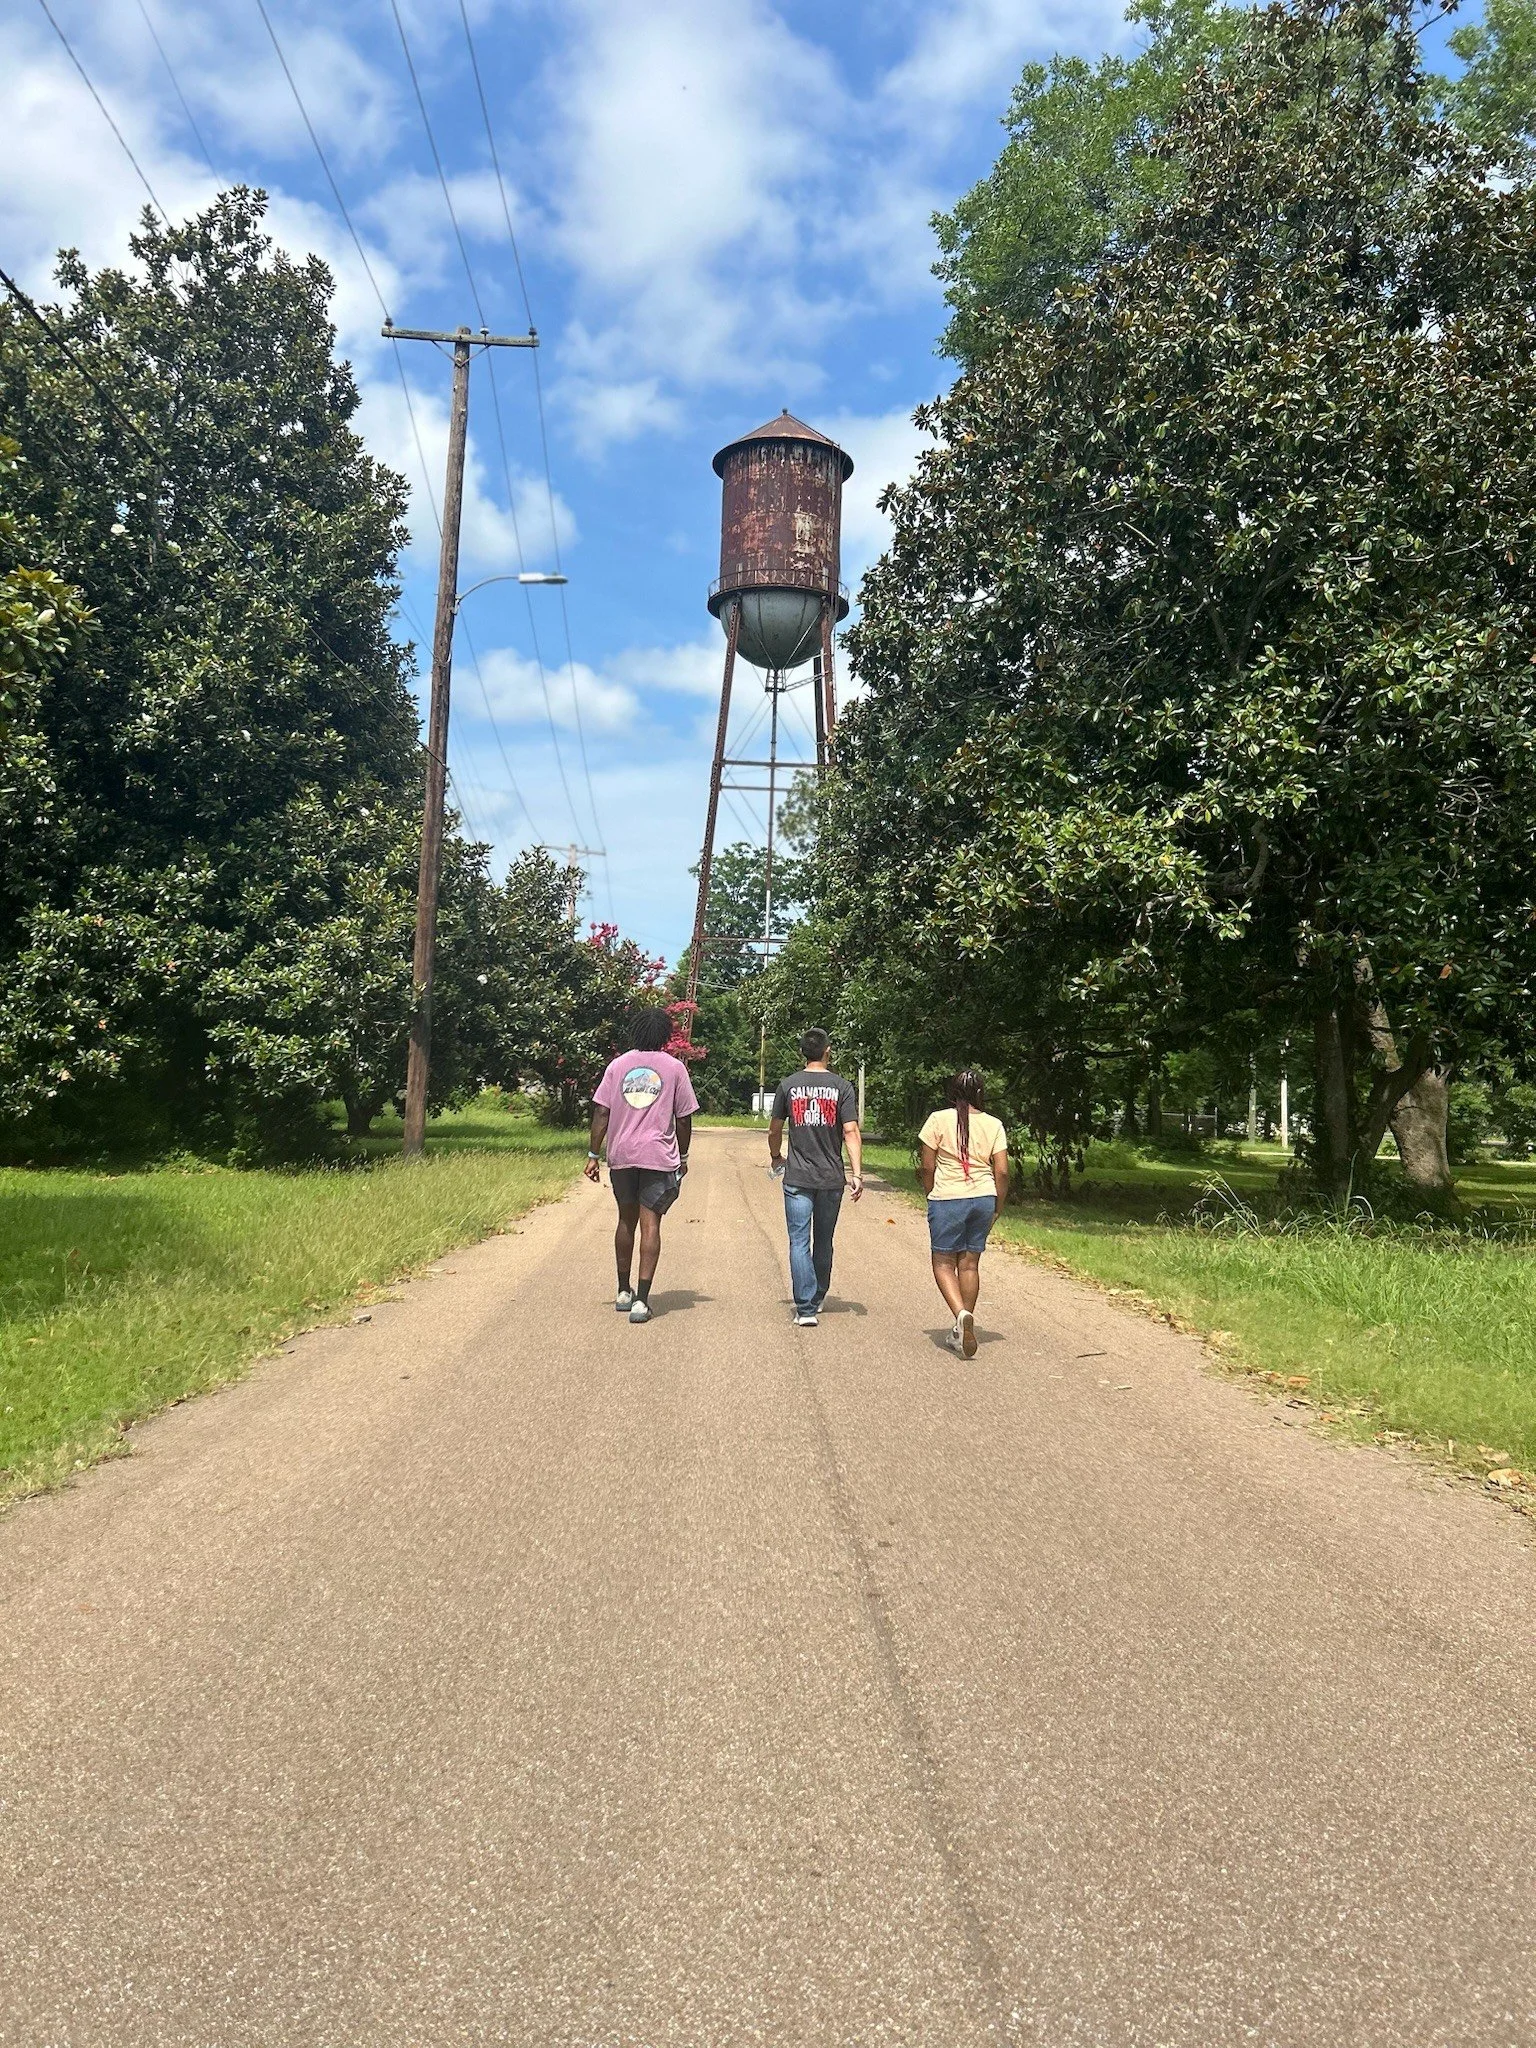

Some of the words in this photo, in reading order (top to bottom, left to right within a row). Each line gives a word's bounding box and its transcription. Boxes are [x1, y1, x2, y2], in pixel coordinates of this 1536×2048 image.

[790, 1086, 839, 1101] SALVATION
[792, 1098, 837, 1113] BELONGS
[804, 1110, 820, 1124] OUR
